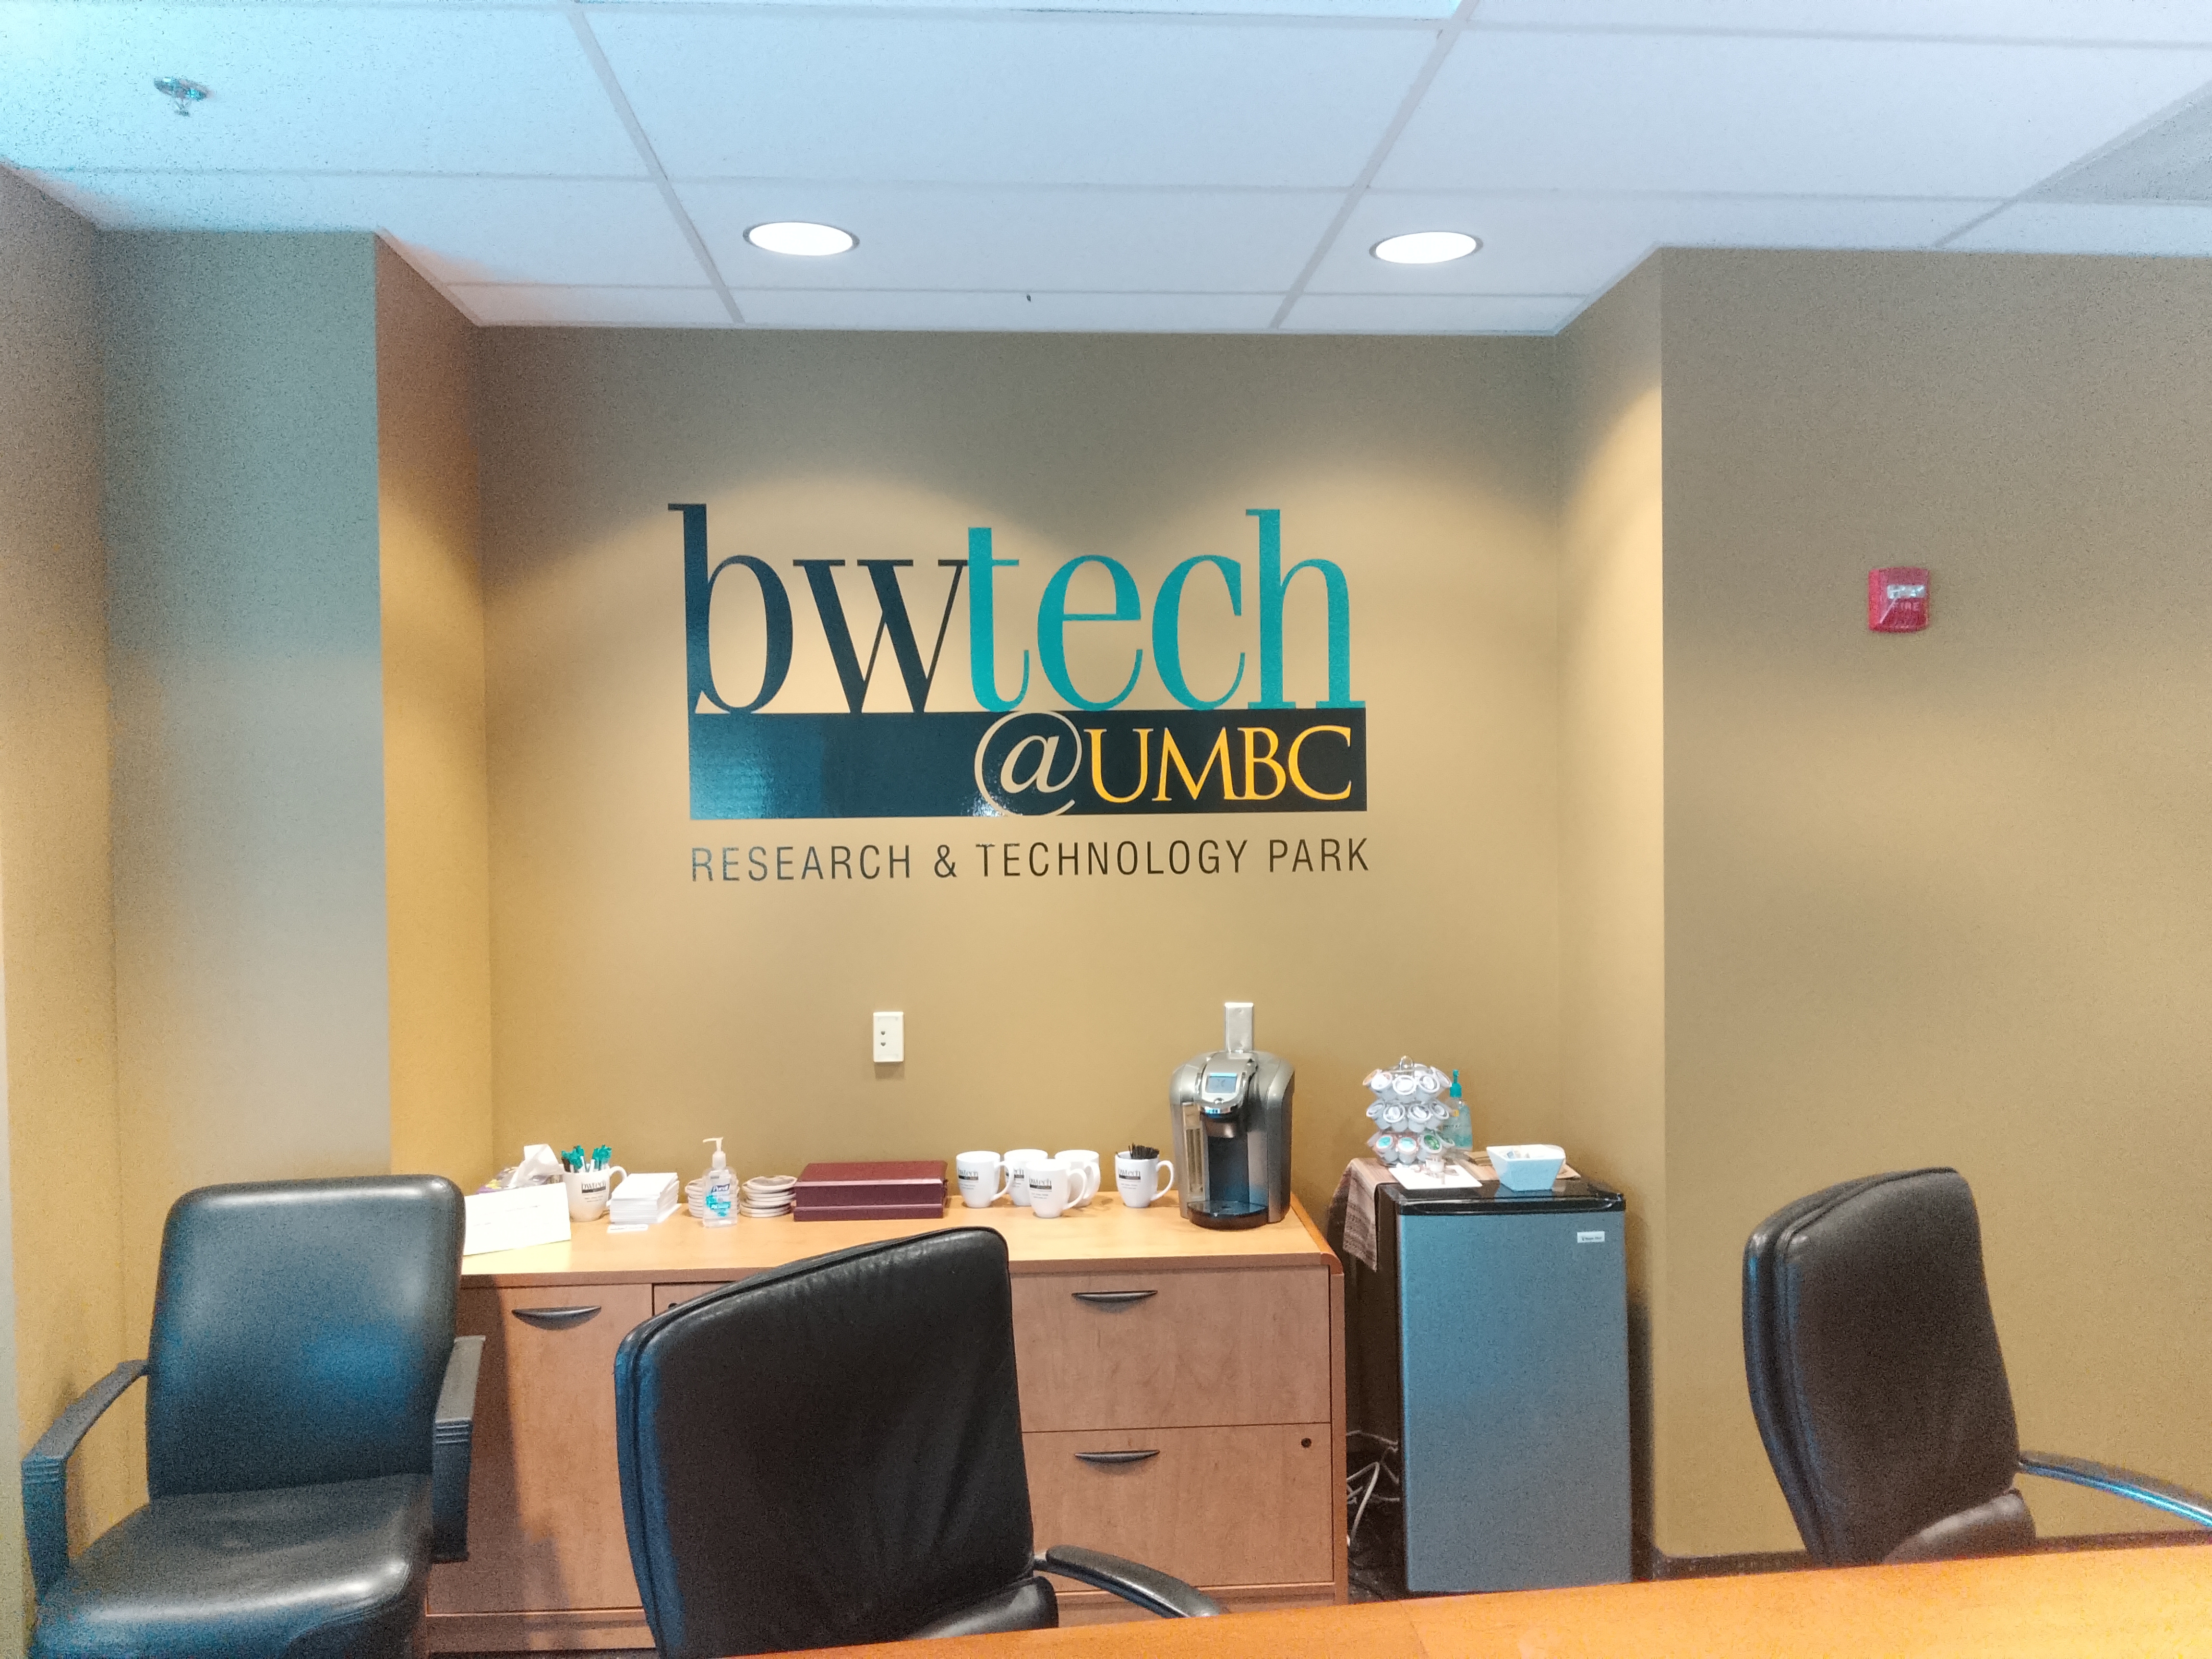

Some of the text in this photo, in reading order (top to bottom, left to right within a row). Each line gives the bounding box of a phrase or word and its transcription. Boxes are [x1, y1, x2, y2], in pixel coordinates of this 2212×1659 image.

[668, 503, 1365, 714] bwtech
[974, 710, 1351, 817] @UMBC
[692, 837, 1370, 881] RESEARCH & TECHNOLOGY PARK
